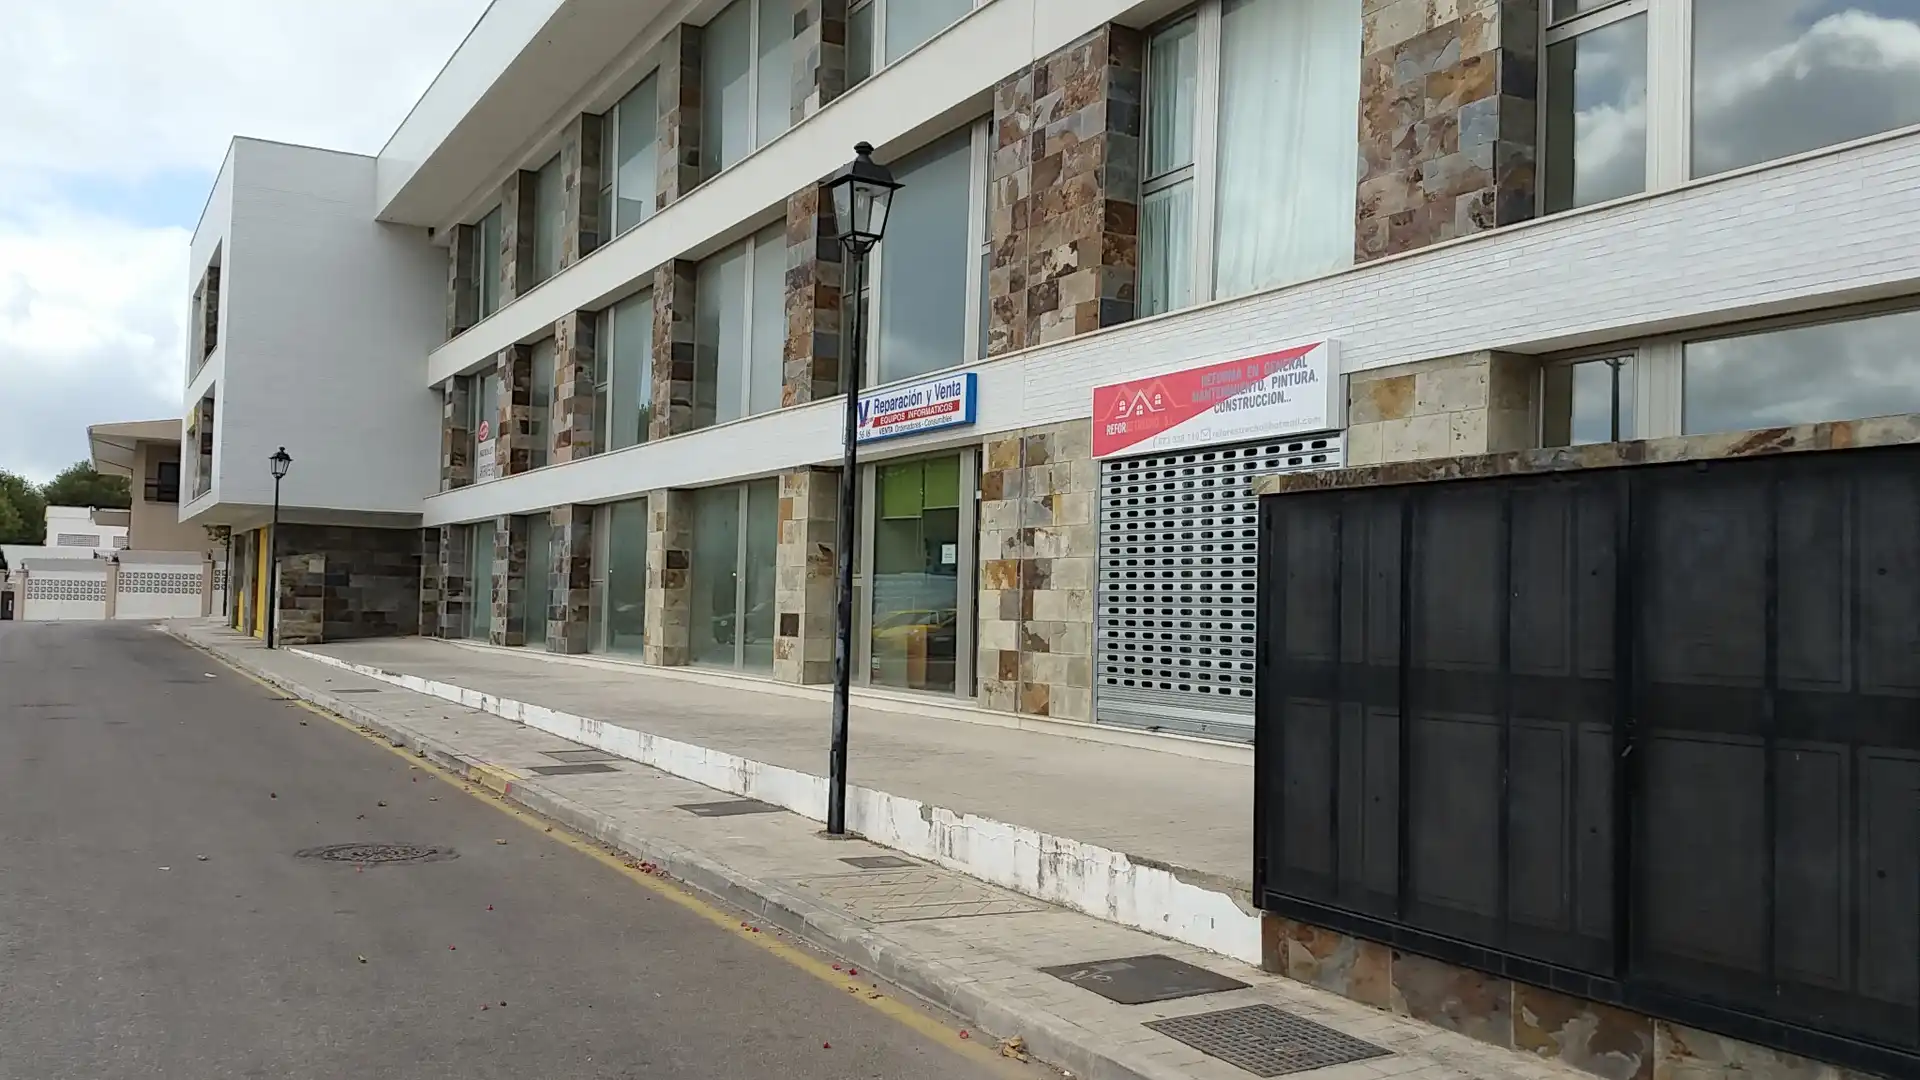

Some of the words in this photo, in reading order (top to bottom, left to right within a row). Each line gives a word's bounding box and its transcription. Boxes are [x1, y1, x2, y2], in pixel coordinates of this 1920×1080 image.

[1201, 367, 1242, 387] REFORMA
[1246, 364, 1259, 377] EN
[1264, 355, 1308, 375] GENERAL
[873, 389, 923, 415] Reparación
[926, 389, 932, 406] y
[934, 380, 961, 401] Venta
[880, 412, 906, 425] EQUIPOS
[907, 402, 953, 419] INFORMATICOS
[878, 426, 893, 435] VENTA
